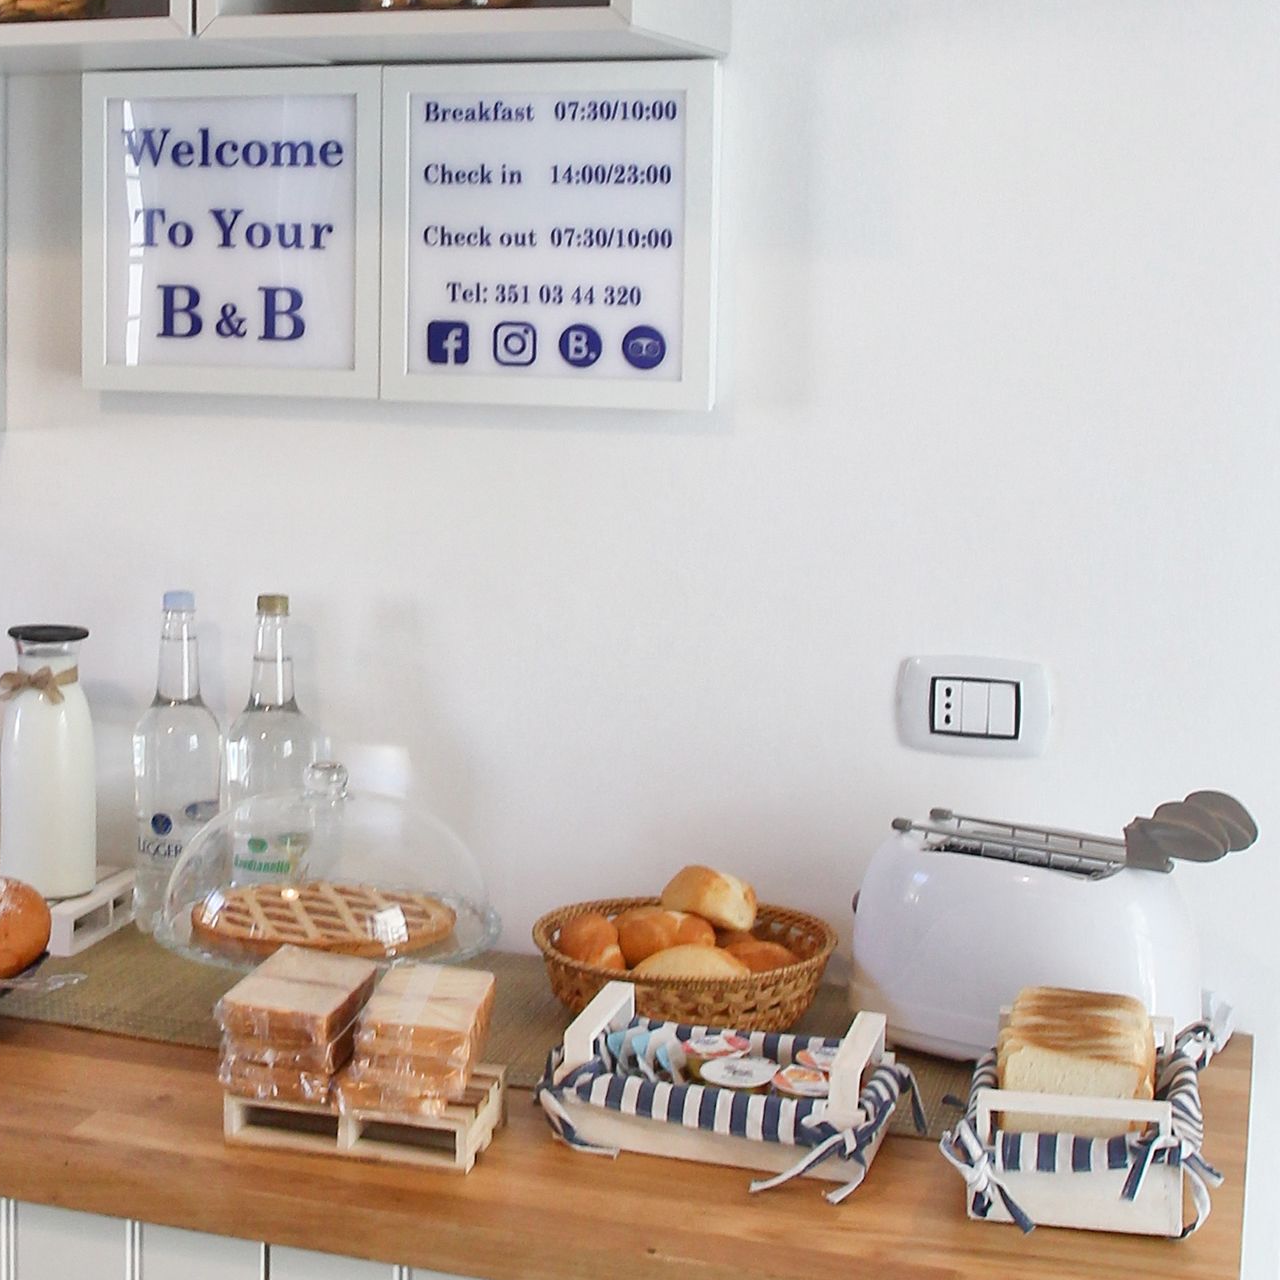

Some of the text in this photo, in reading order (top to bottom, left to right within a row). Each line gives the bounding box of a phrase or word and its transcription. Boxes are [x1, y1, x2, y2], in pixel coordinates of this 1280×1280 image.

[424, 100, 677, 122] Breakfast 07:30/10:00
[121, 127, 344, 168] Welcome
[423, 163, 672, 185] Check in 14:00/23:00
[133, 208, 334, 249] To Your
[423, 225, 673, 249] Check out 07:30/10:00
[446, 282, 642, 307] Tel: 351 03 44 320
[156, 284, 306, 341] B & B
